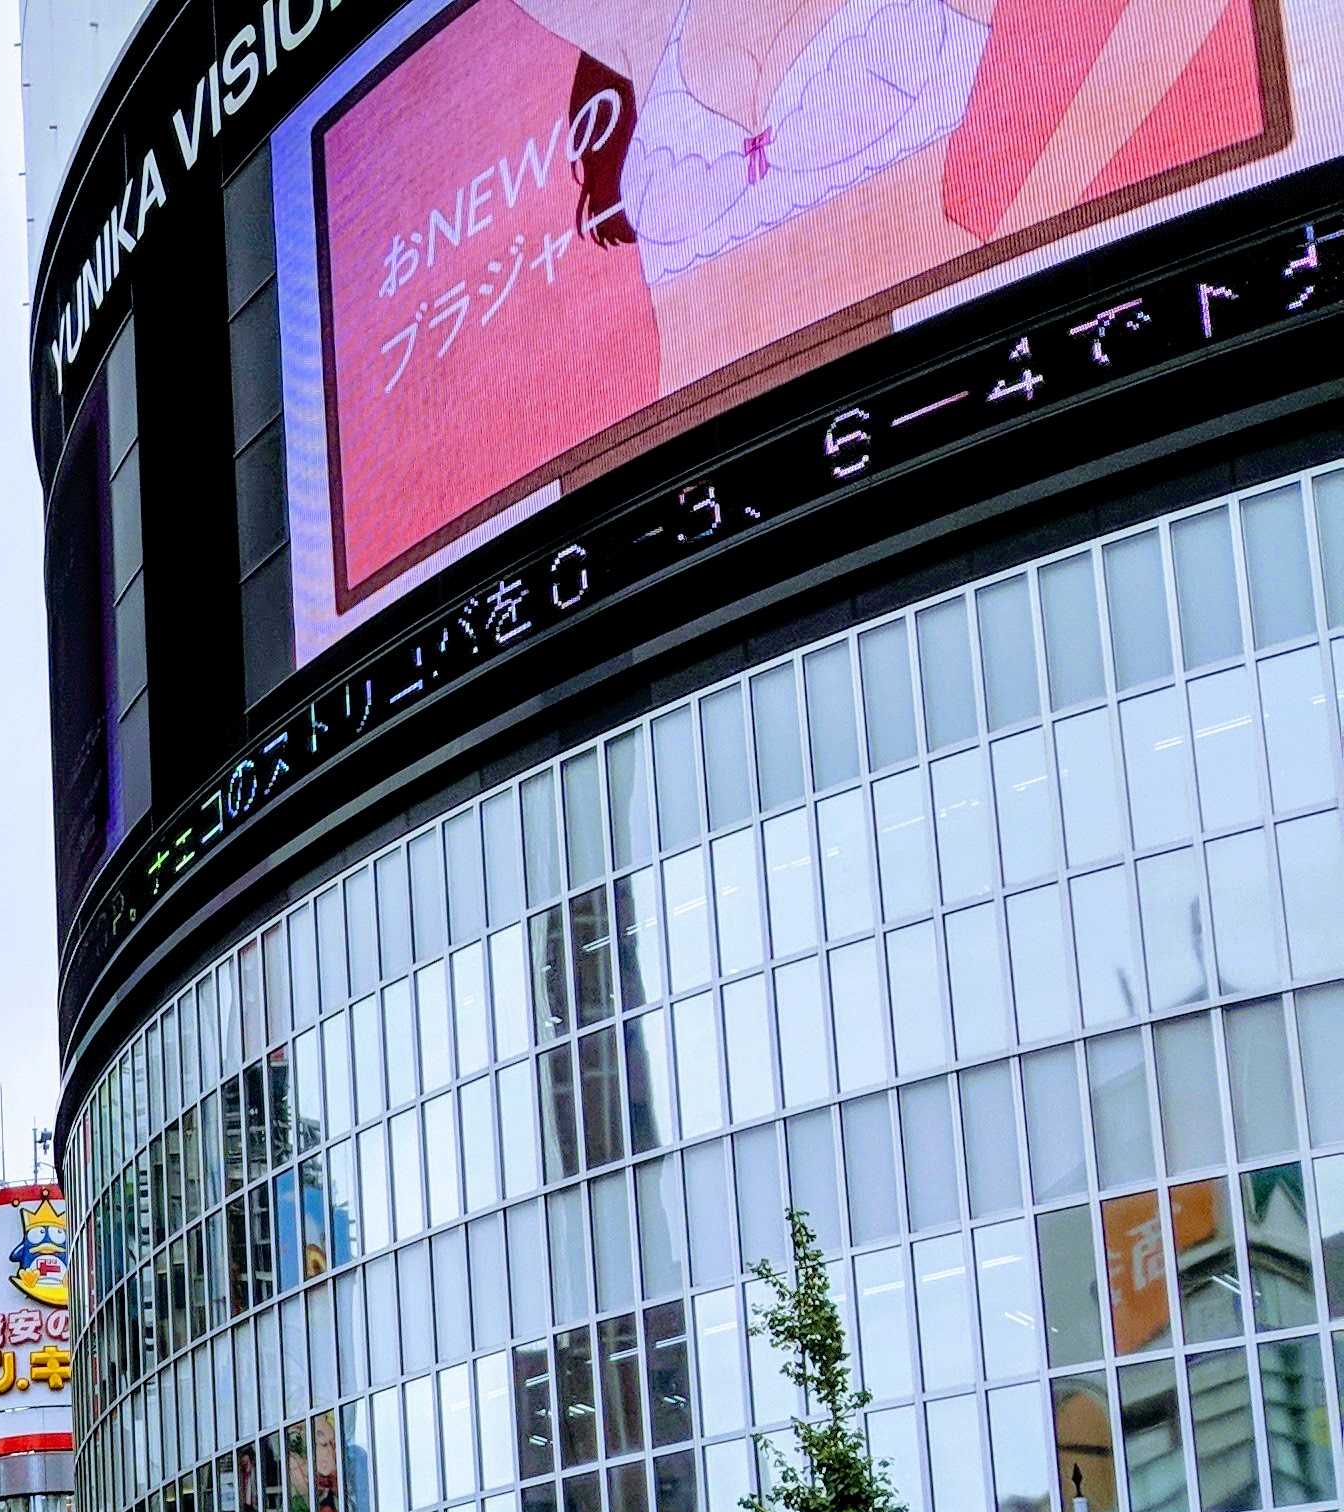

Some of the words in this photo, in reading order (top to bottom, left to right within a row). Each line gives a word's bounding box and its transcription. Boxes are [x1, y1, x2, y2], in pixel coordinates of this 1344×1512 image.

[51, 149, 167, 393] YUNIKA
[172, 0, 341, 170] VISIO
[377, 88, 622, 297] おNEWの
[381, 204, 625, 393] ブラジャー
